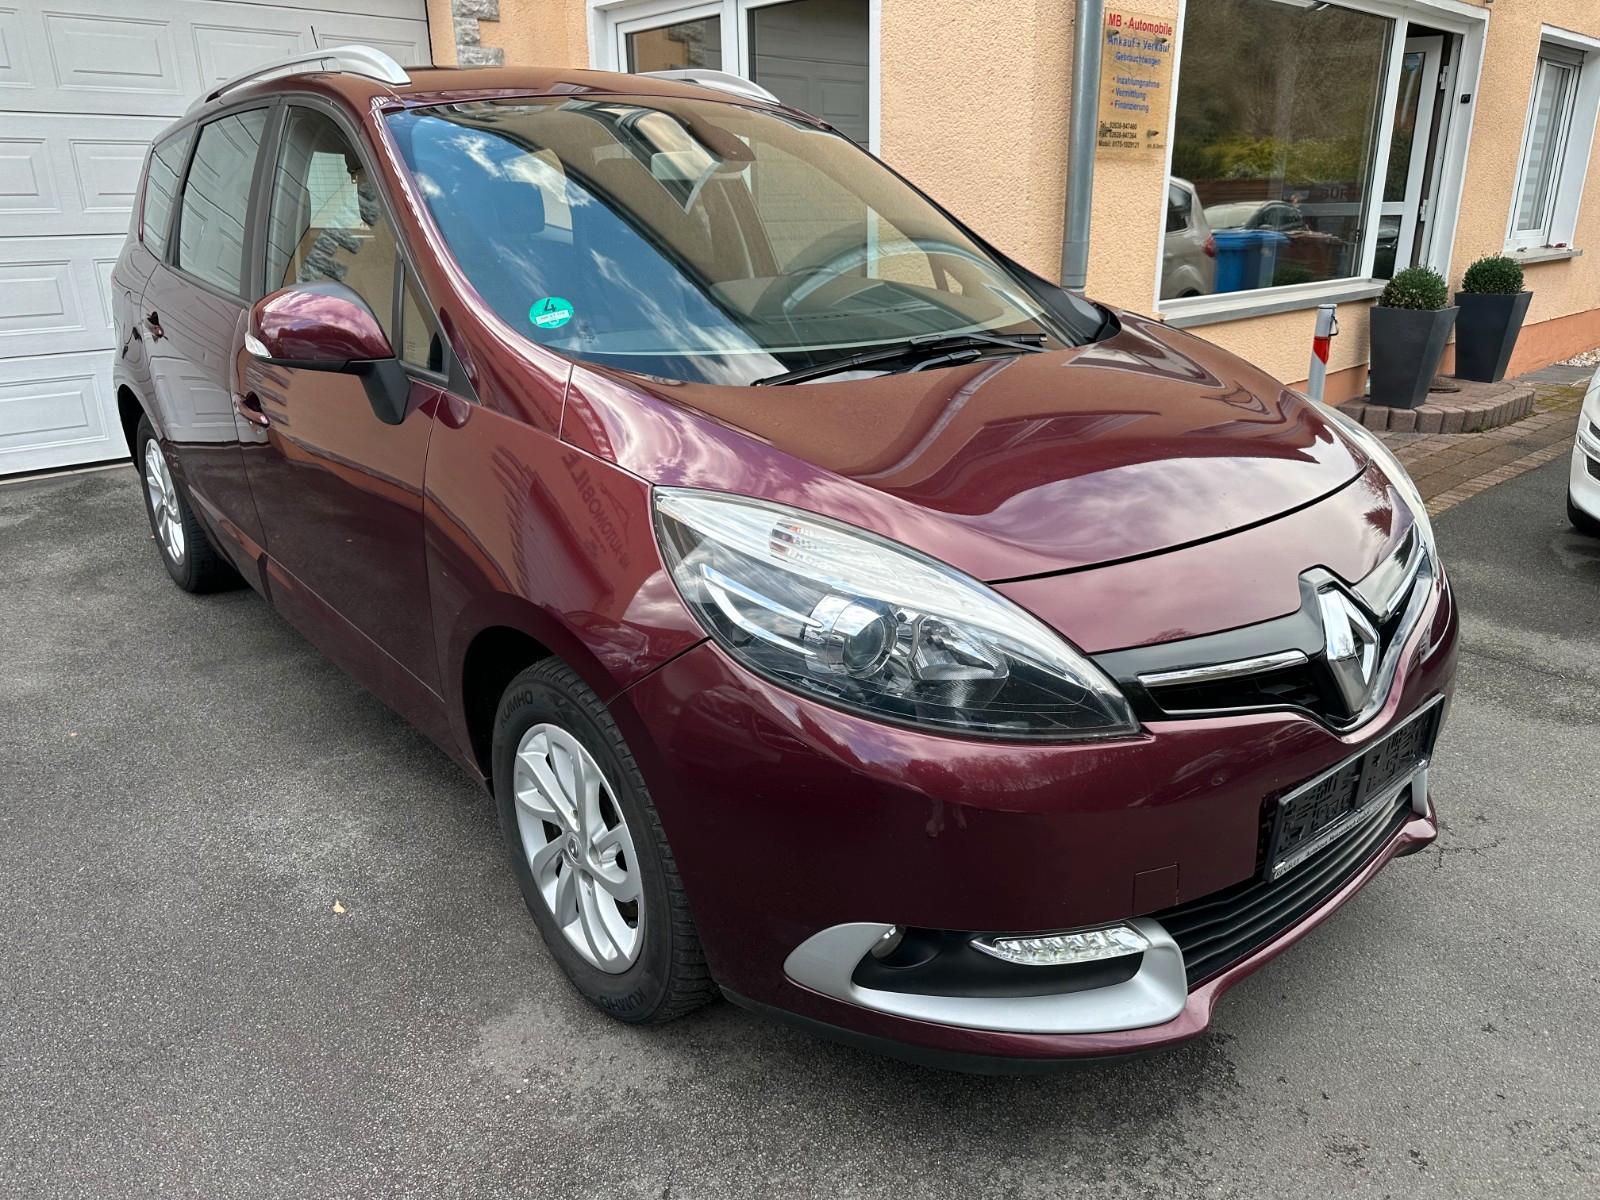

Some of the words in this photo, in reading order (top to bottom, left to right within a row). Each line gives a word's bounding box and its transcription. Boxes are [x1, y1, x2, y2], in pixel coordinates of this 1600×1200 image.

[1108, 13, 1122, 27] MB
[1128, 17, 1172, 36] Automobile
[1108, 35, 1135, 48] Ankauf
[1143, 40, 1170, 52] Verkauf
[544, 298, 556, 312] 4
